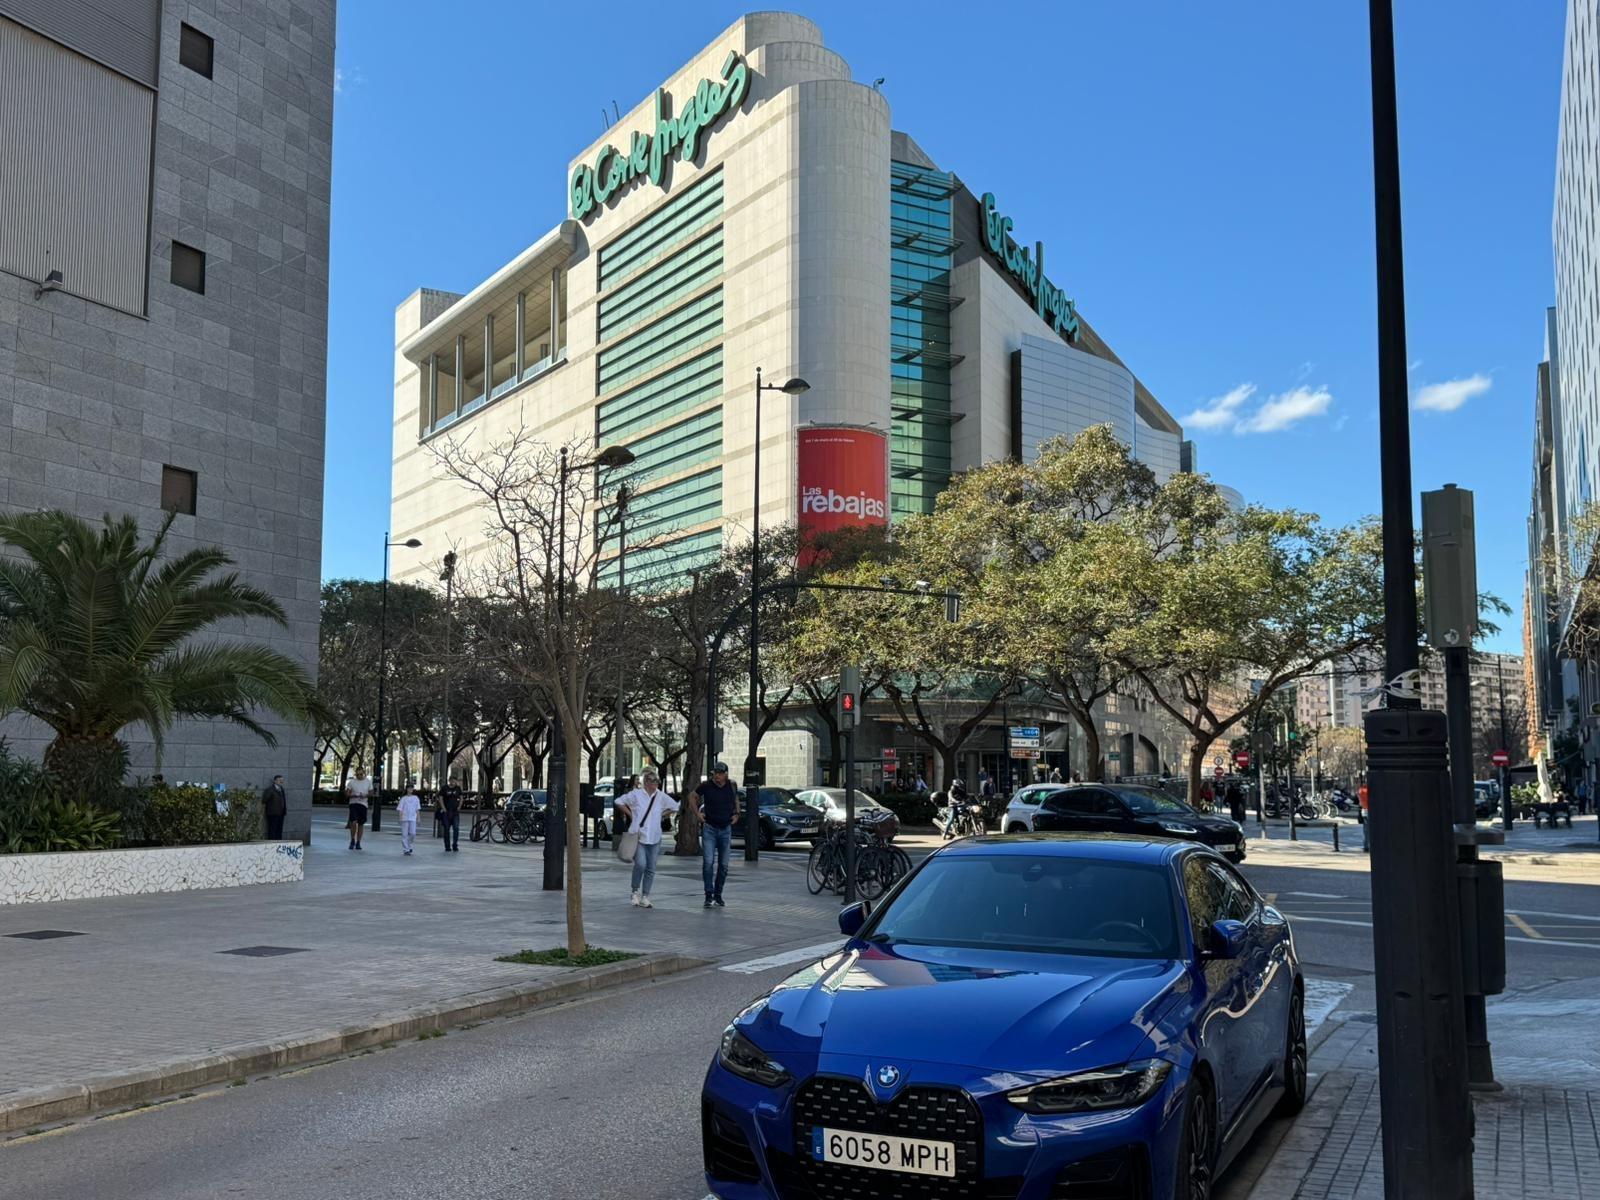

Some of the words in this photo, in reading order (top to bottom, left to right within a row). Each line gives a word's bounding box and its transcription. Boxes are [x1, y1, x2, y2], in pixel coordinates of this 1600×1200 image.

[570, 163, 595, 220] El
[593, 144, 651, 203] Corte
[982, 192, 1003, 258] El
[1001, 216, 1037, 297] Corte
[803, 486, 822, 495] Las
[803, 489, 885, 519] rebajas
[830, 1134, 892, 1165] 6058
[900, 1142, 949, 1172] MPH
